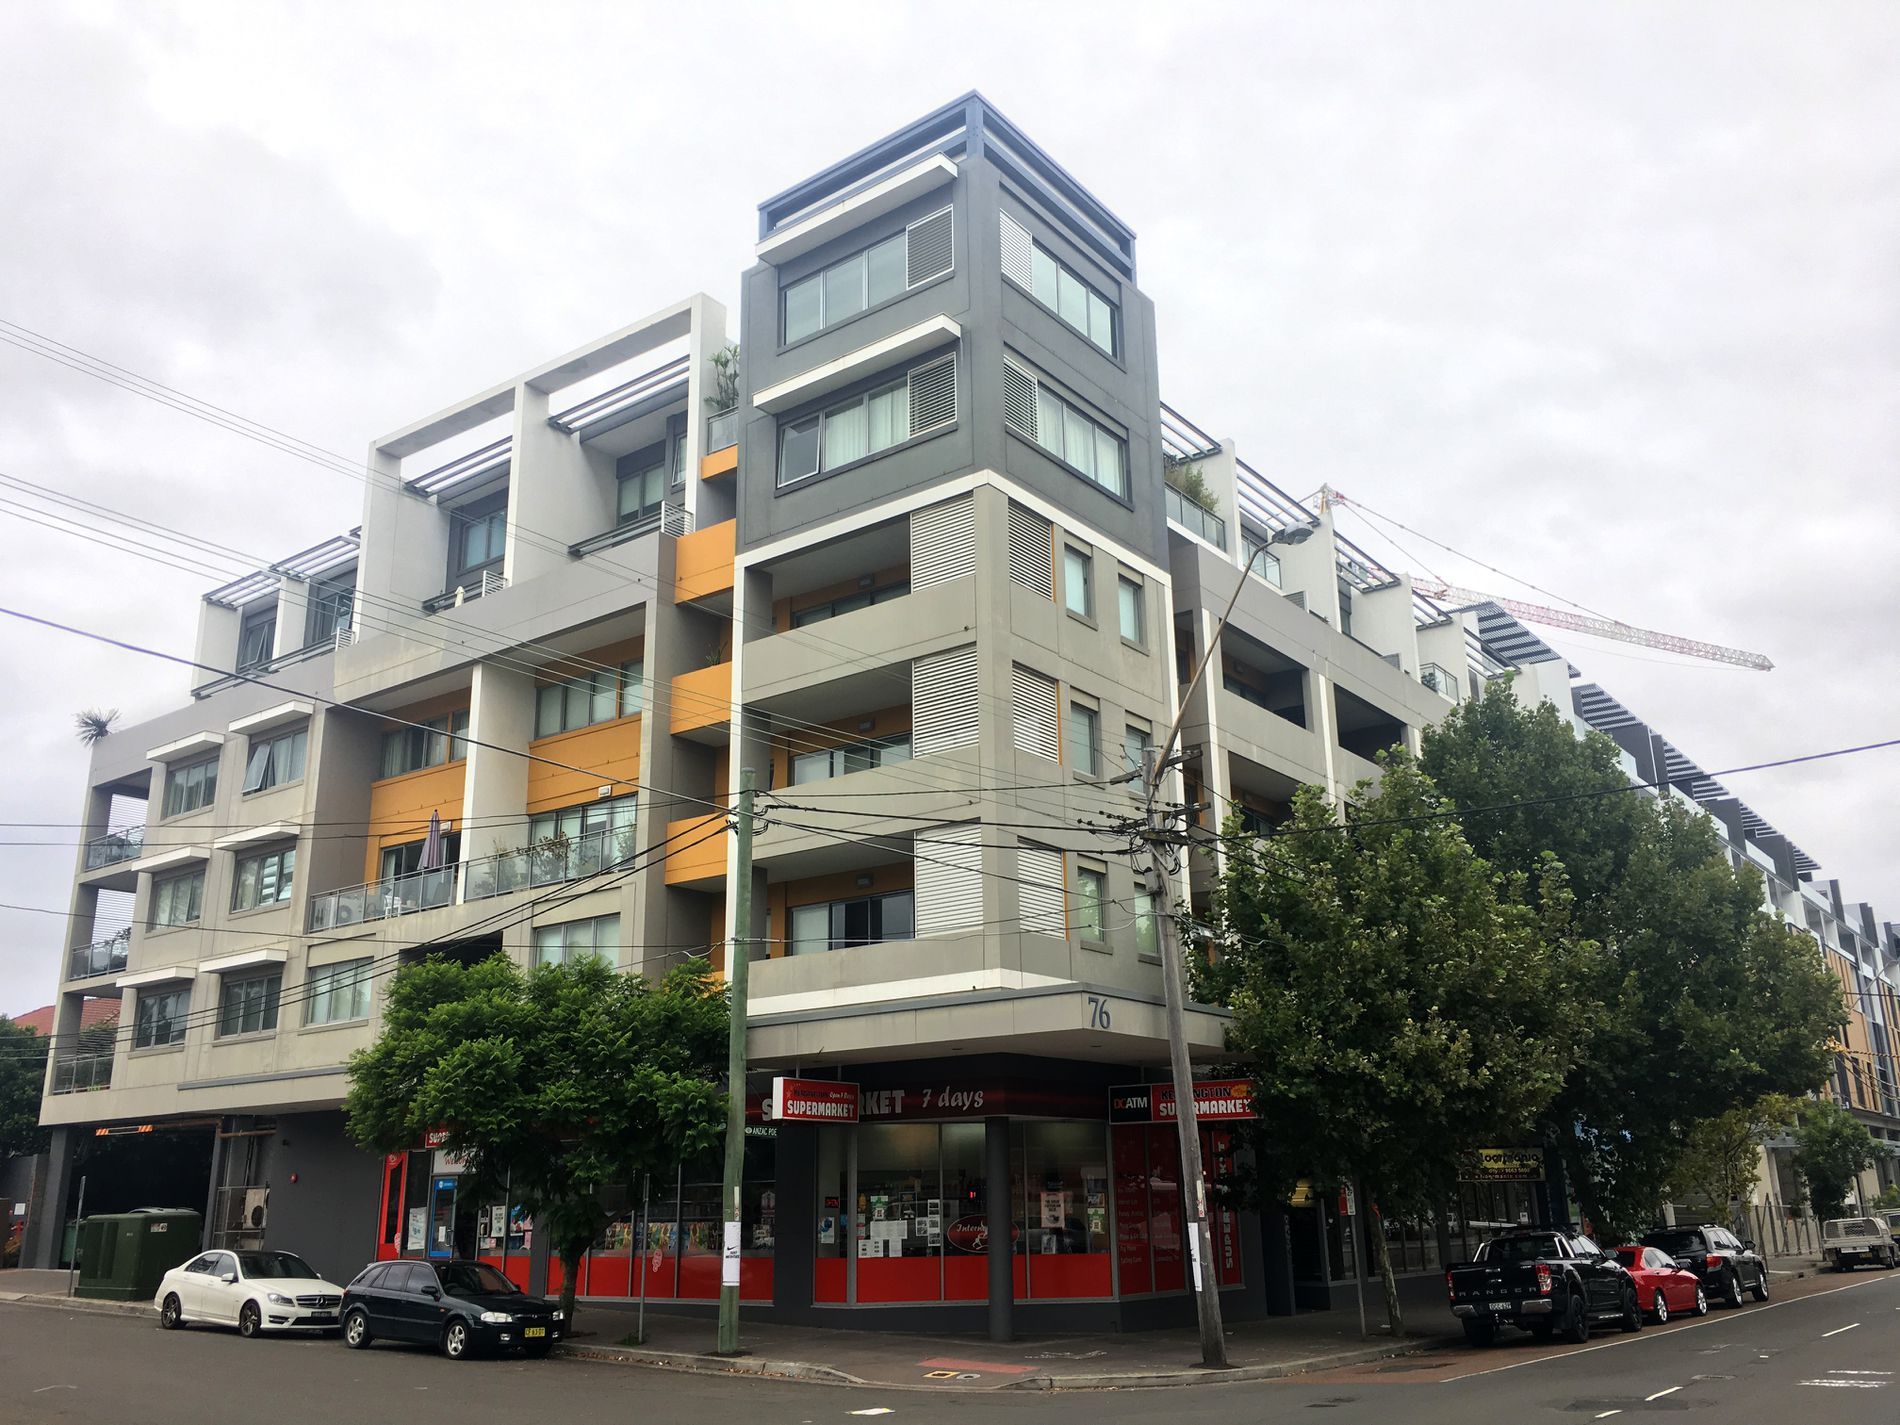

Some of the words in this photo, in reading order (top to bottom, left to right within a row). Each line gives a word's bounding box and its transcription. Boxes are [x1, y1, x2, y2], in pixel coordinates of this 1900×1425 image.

[1088, 996, 1111, 1029] 76
[922, 1088, 932, 1108] 7
[938, 1086, 984, 1111] days
[787, 1100, 854, 1118] SUPERMARKET
[752, 1127, 768, 1136] ANZAC
[1459, 1287, 1537, 1297] RANGER
